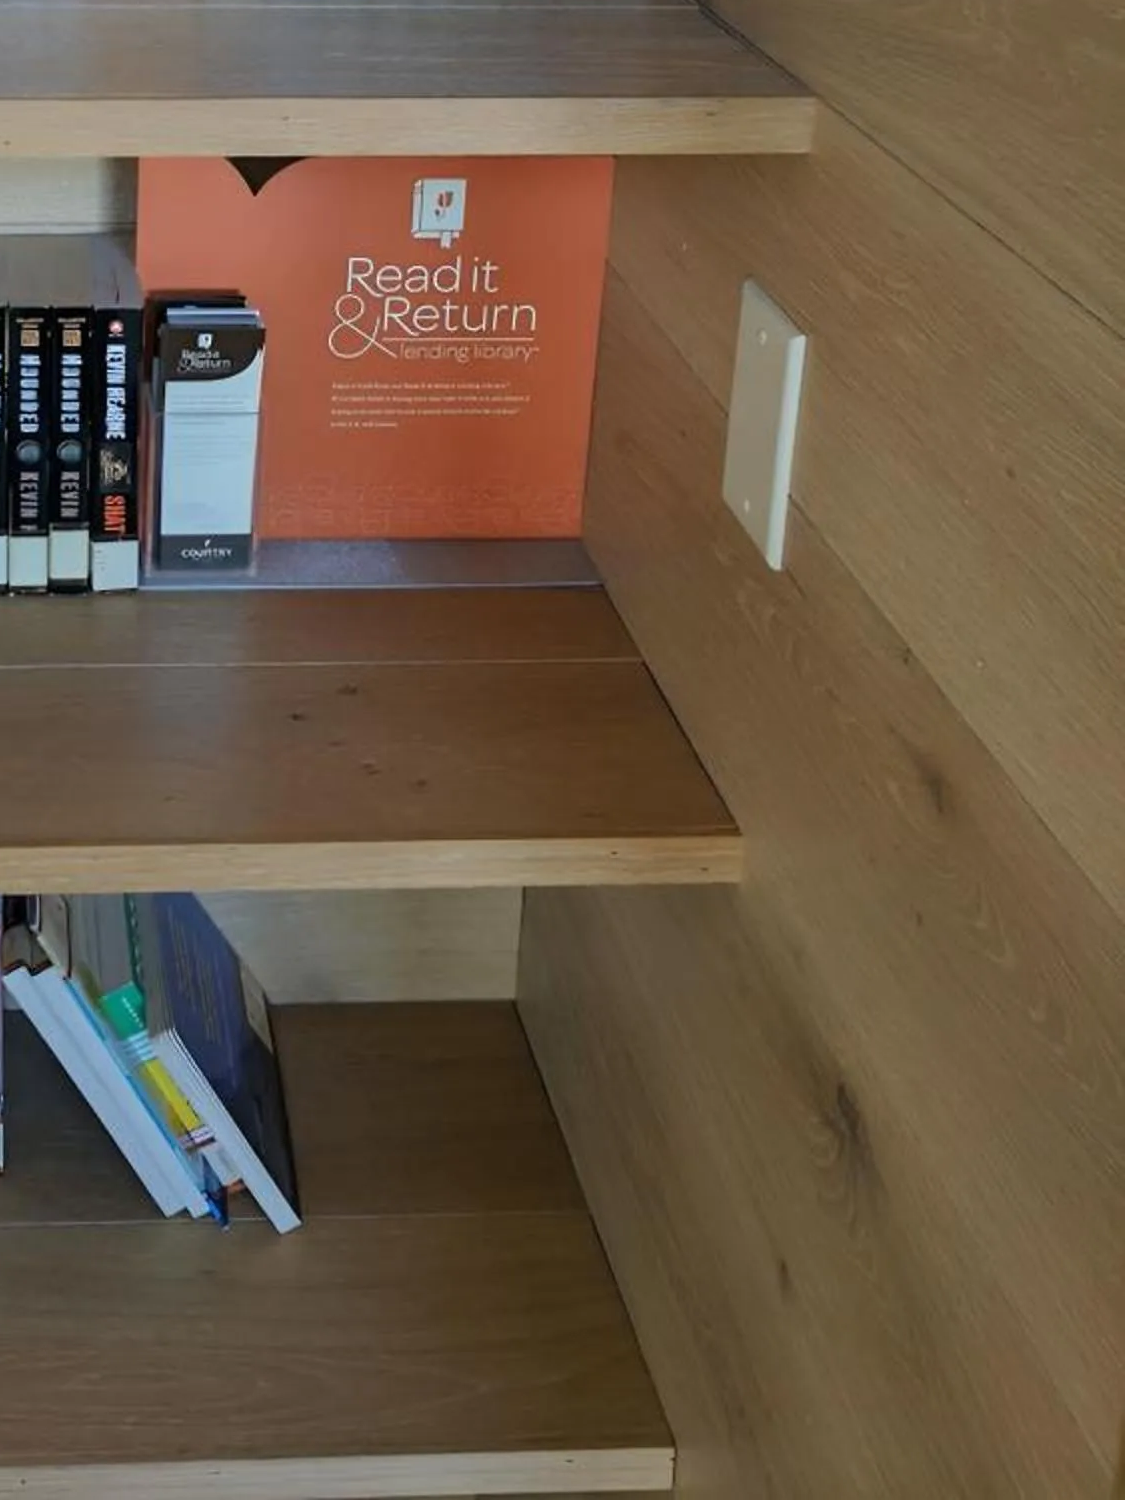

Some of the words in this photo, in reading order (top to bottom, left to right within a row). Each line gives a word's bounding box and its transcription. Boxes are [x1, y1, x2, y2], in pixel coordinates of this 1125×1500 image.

[346, 256, 461, 298] Read
[472, 258, 499, 293] it
[328, 293, 397, 359] &
[382, 296, 538, 337] Return
[106, 344, 126, 384] KEVIN
[400, 342, 470, 363] lending
[474, 342, 532, 363] library
[19, 354, 41, 433] HOUNDED
[60, 354, 82, 433] HOUNDED
[20, 471, 40, 518] KEVIN
[60, 471, 80, 518] KEVIN
